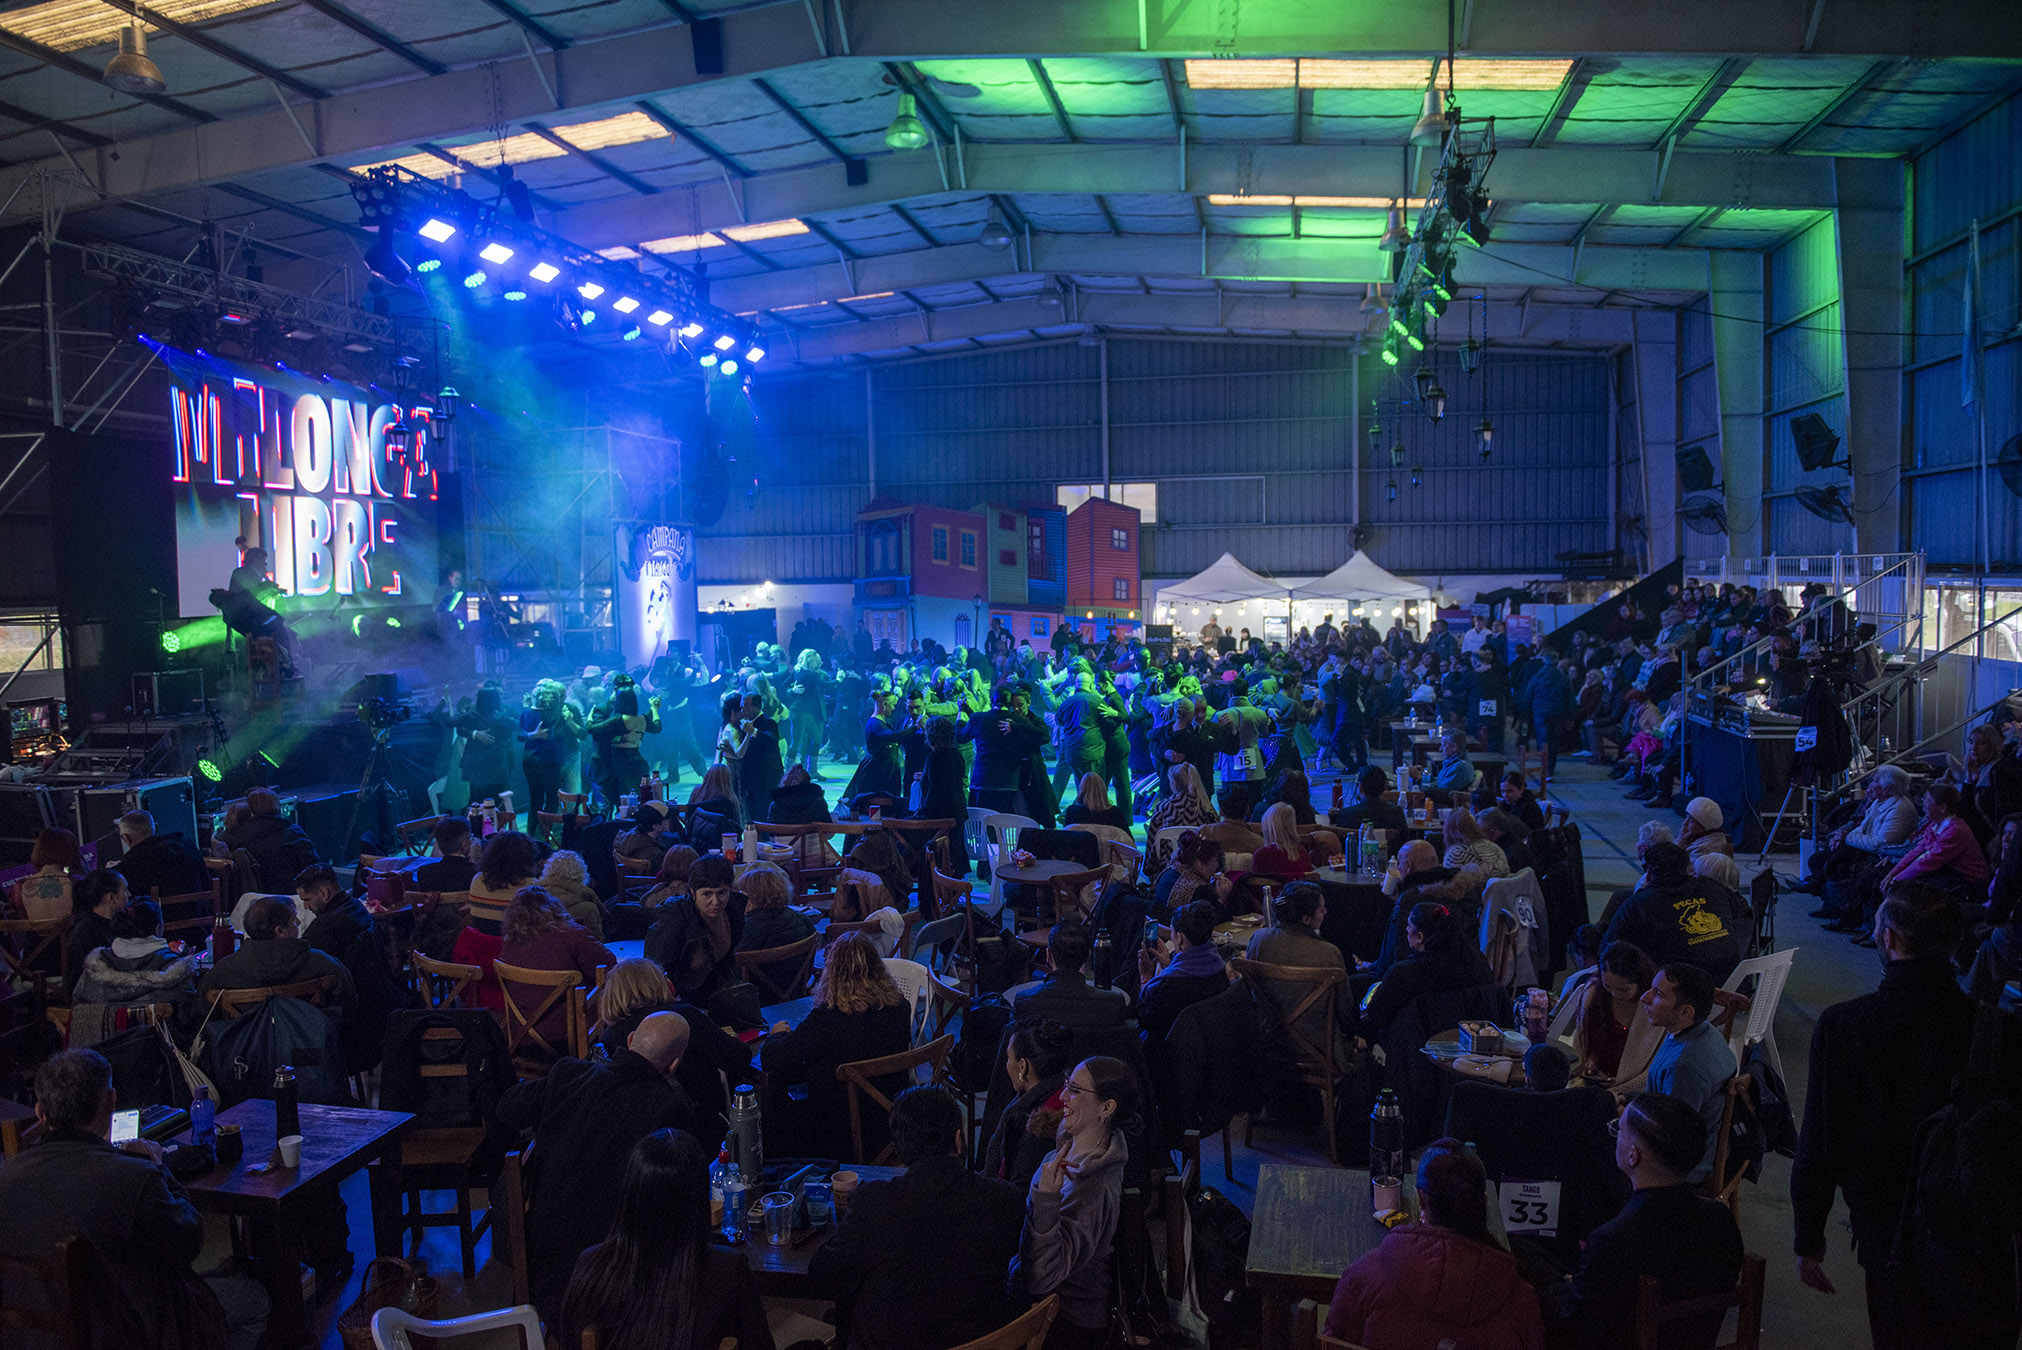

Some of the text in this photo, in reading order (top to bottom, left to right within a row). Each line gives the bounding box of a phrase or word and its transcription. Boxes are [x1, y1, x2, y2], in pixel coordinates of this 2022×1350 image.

[236, 491, 402, 598] LIBRE
[1798, 736, 1814, 748] 54
[1238, 755, 1252, 766] 15
[1518, 907, 1532, 922] 90
[1522, 1184, 1541, 1194] TANGO
[1508, 1199, 1549, 1225] 33
